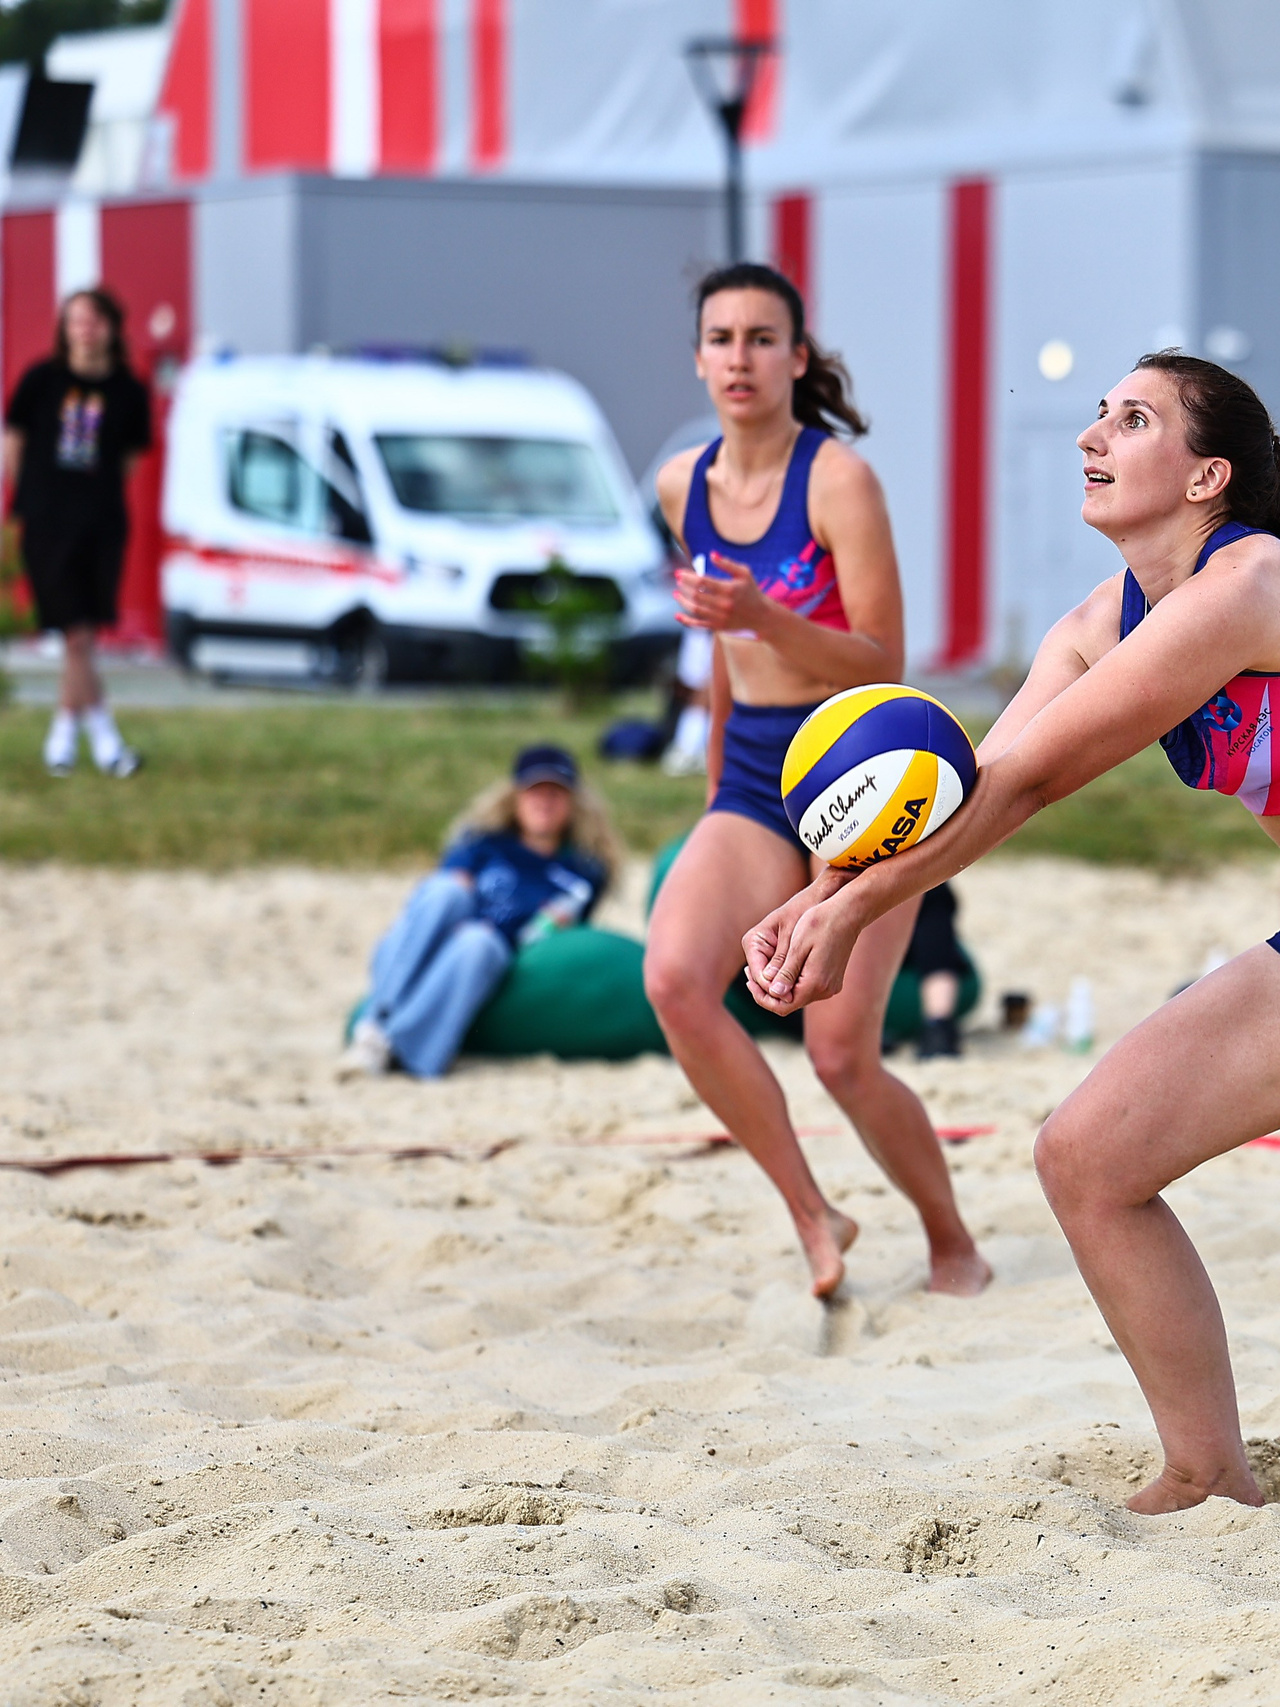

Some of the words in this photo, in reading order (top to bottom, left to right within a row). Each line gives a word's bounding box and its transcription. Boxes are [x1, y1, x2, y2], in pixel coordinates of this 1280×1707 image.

[1227, 723, 1257, 757] КУРСКАЯ
[1256, 708, 1272, 724] АЭС
[1246, 726, 1274, 757] РОСАТОМ
[804, 814, 833, 850] Beach
[828, 773, 876, 822] Champ
